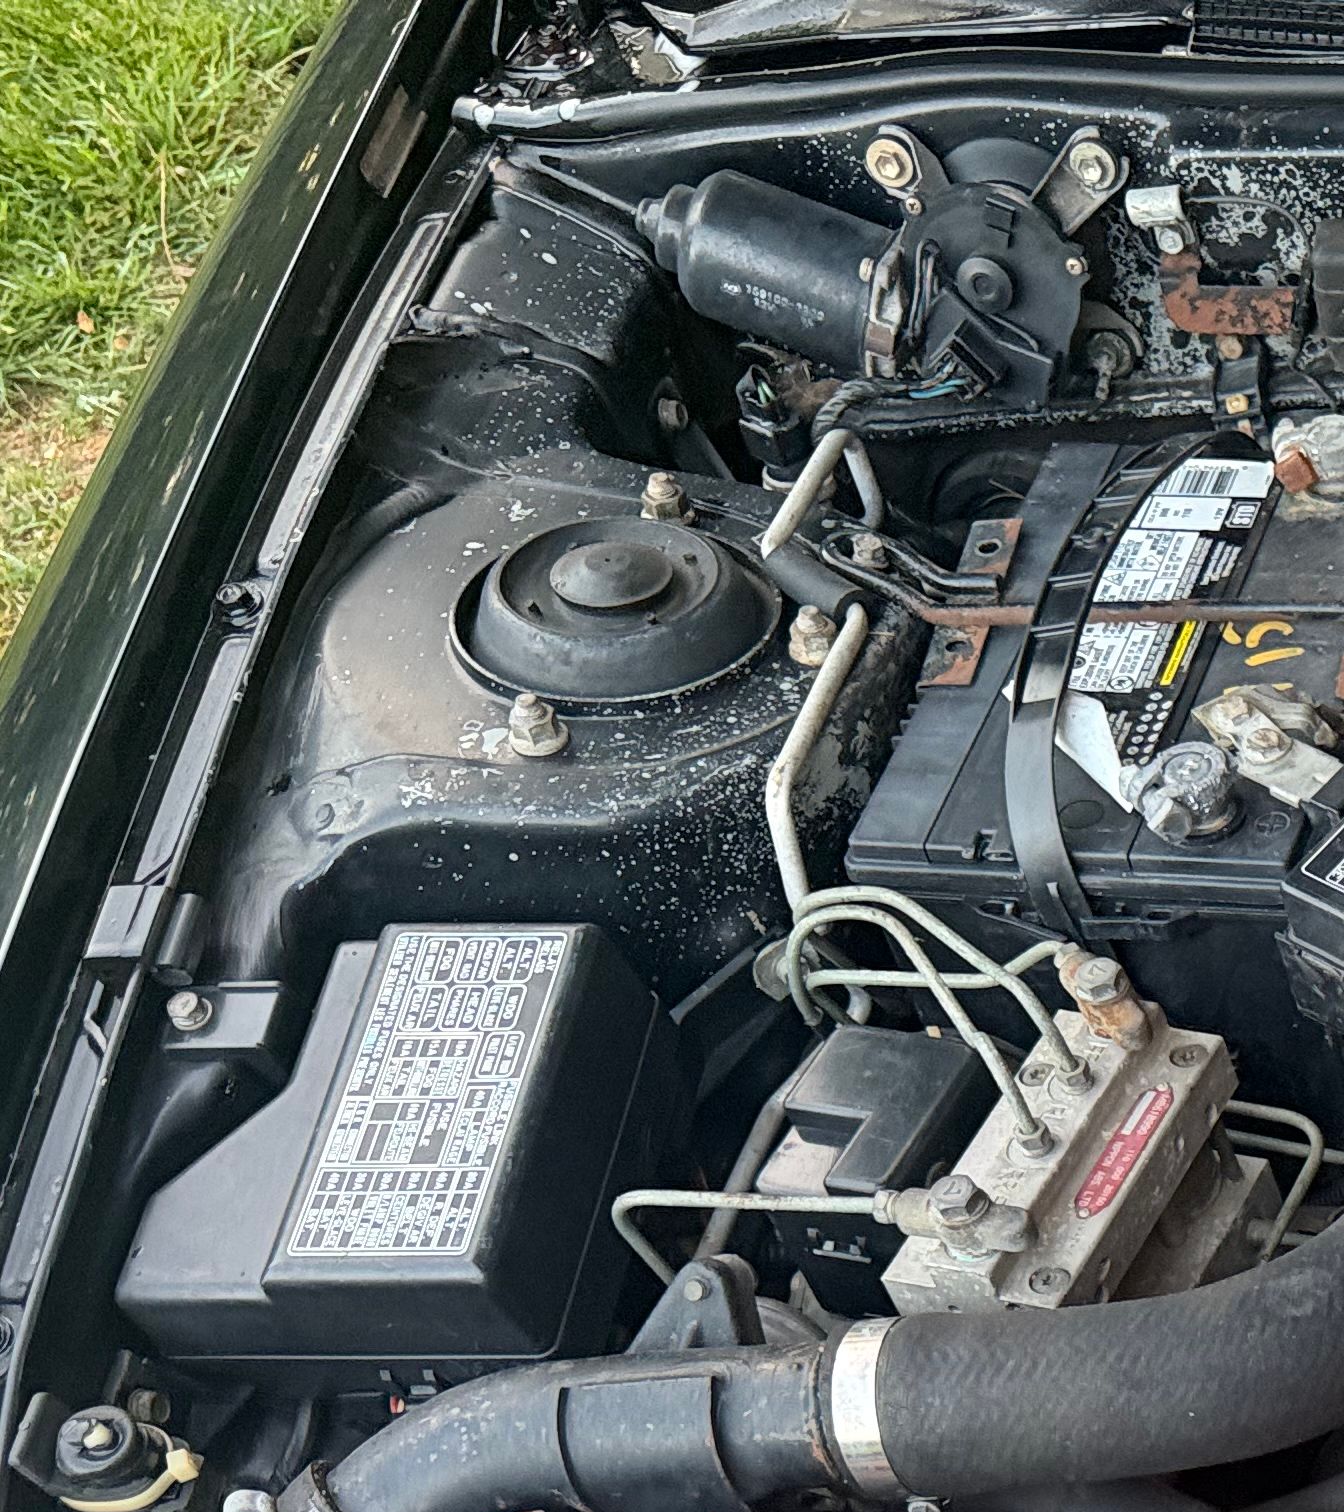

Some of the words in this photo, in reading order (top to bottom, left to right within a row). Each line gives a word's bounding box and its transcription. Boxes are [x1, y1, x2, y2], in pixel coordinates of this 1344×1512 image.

[437, 947, 457, 970] FOG
[497, 946, 518, 973] ALT.
[515, 946, 536, 973] ALT.
[421, 992, 443, 1023] TAIL
[460, 991, 482, 1023] HEAD
[416, 1102, 443, 1147] FUSIBLE
[435, 1102, 455, 1130] FUSE
[440, 1206, 460, 1232] ALT.
[454, 1206, 473, 1232] ALT.
